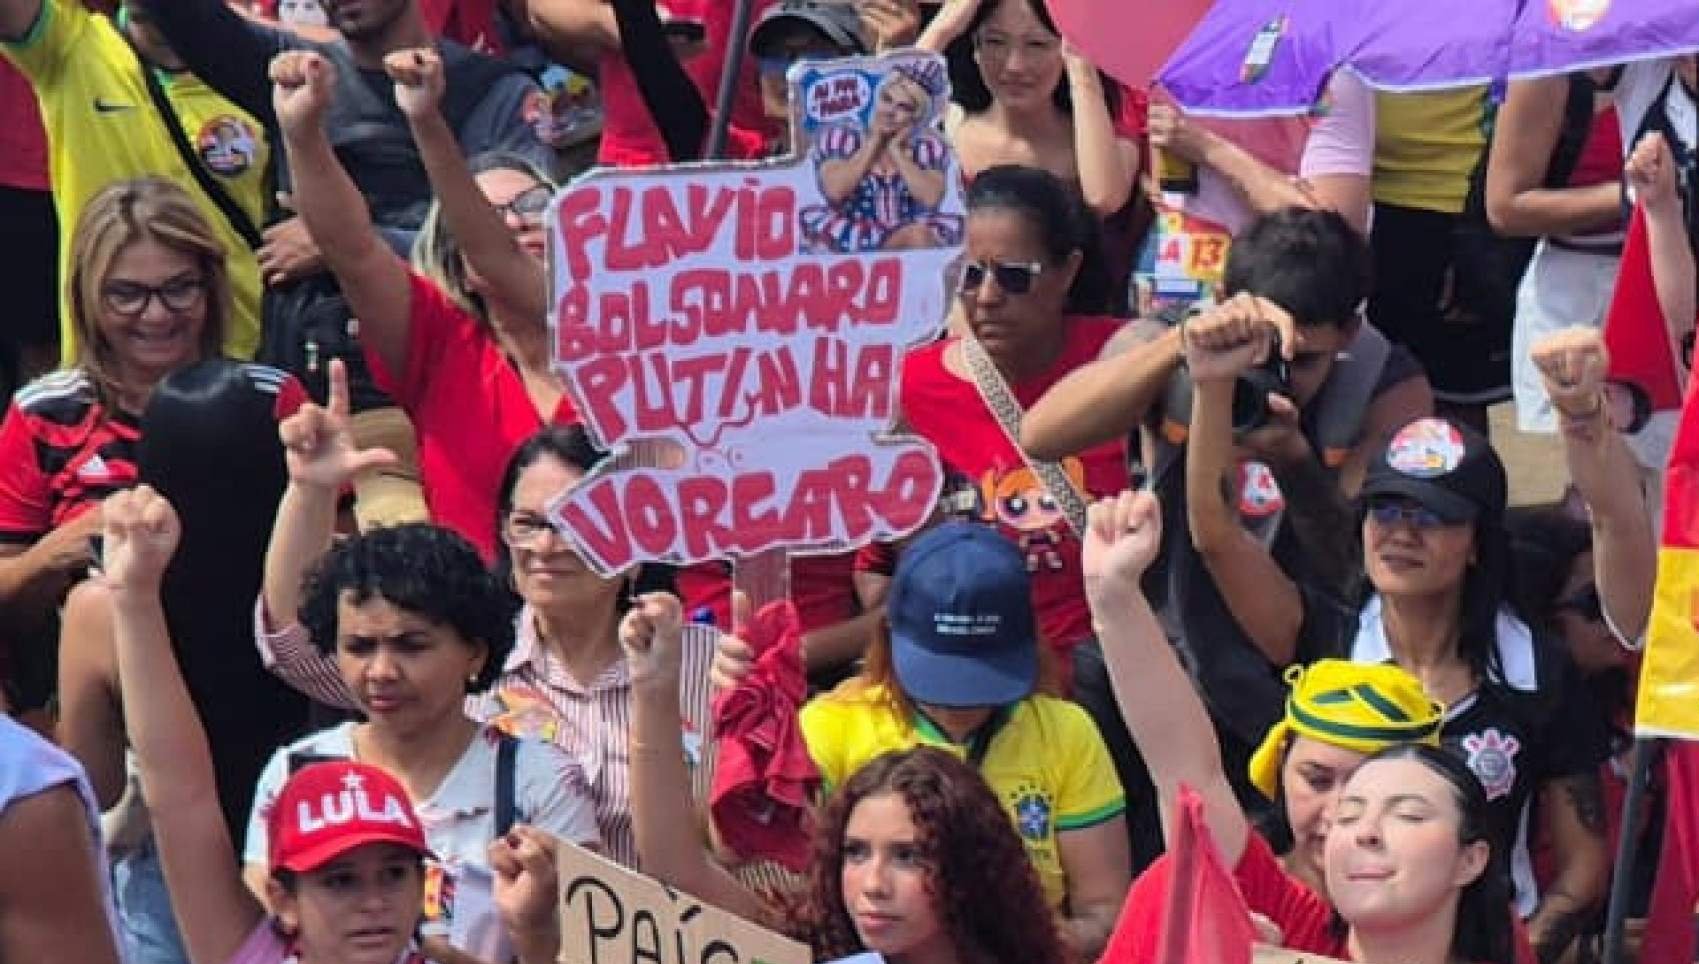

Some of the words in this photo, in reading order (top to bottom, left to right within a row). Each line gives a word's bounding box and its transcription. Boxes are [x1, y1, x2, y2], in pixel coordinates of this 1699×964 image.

[558, 176, 796, 282] FLAVIO
[558, 257, 904, 362] BOLSONARO
[557, 450, 937, 570] VORCARO
[297, 788, 415, 834] LULA
